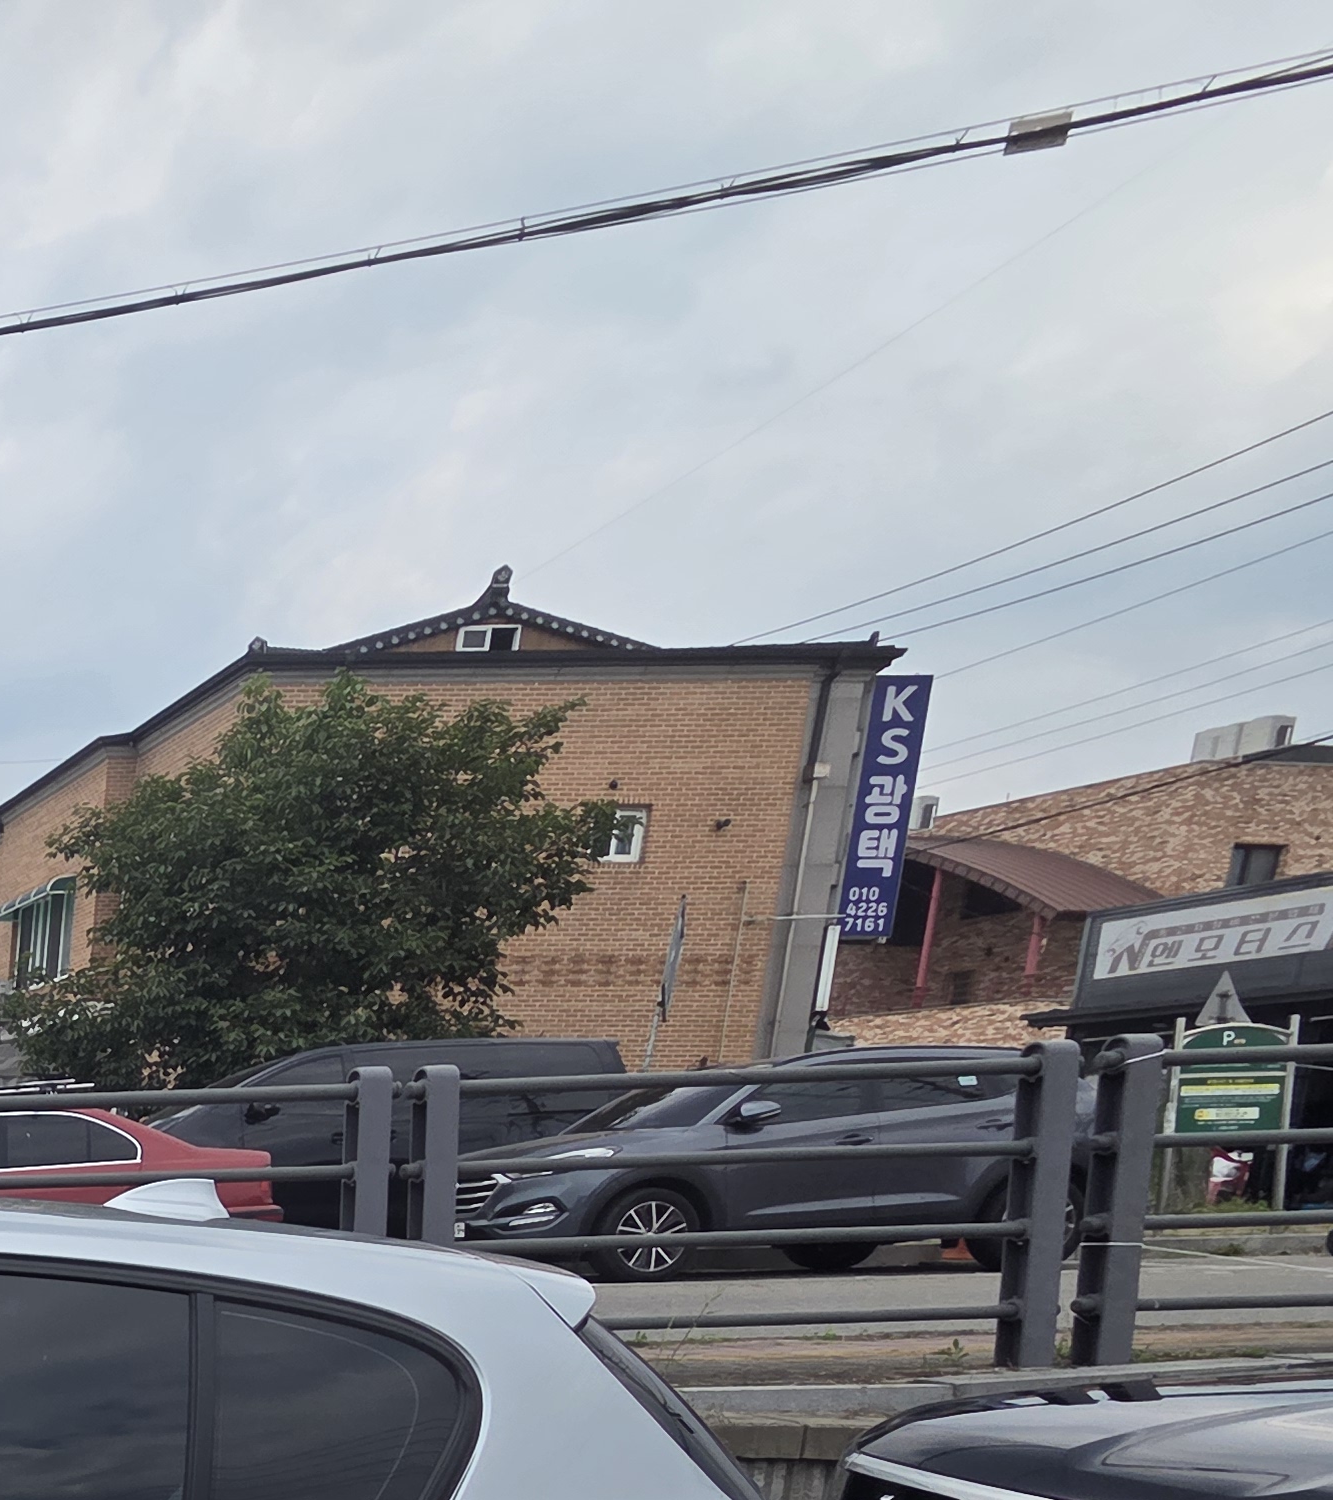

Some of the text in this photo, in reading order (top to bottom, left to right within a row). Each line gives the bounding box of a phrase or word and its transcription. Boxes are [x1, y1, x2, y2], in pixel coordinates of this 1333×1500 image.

[856, 774, 908, 877] 광택
[849, 886, 880, 901] 010
[846, 902, 888, 917] 4226
[844, 918, 885, 932] 7161
[1222, 1030, 1236, 1046] P
